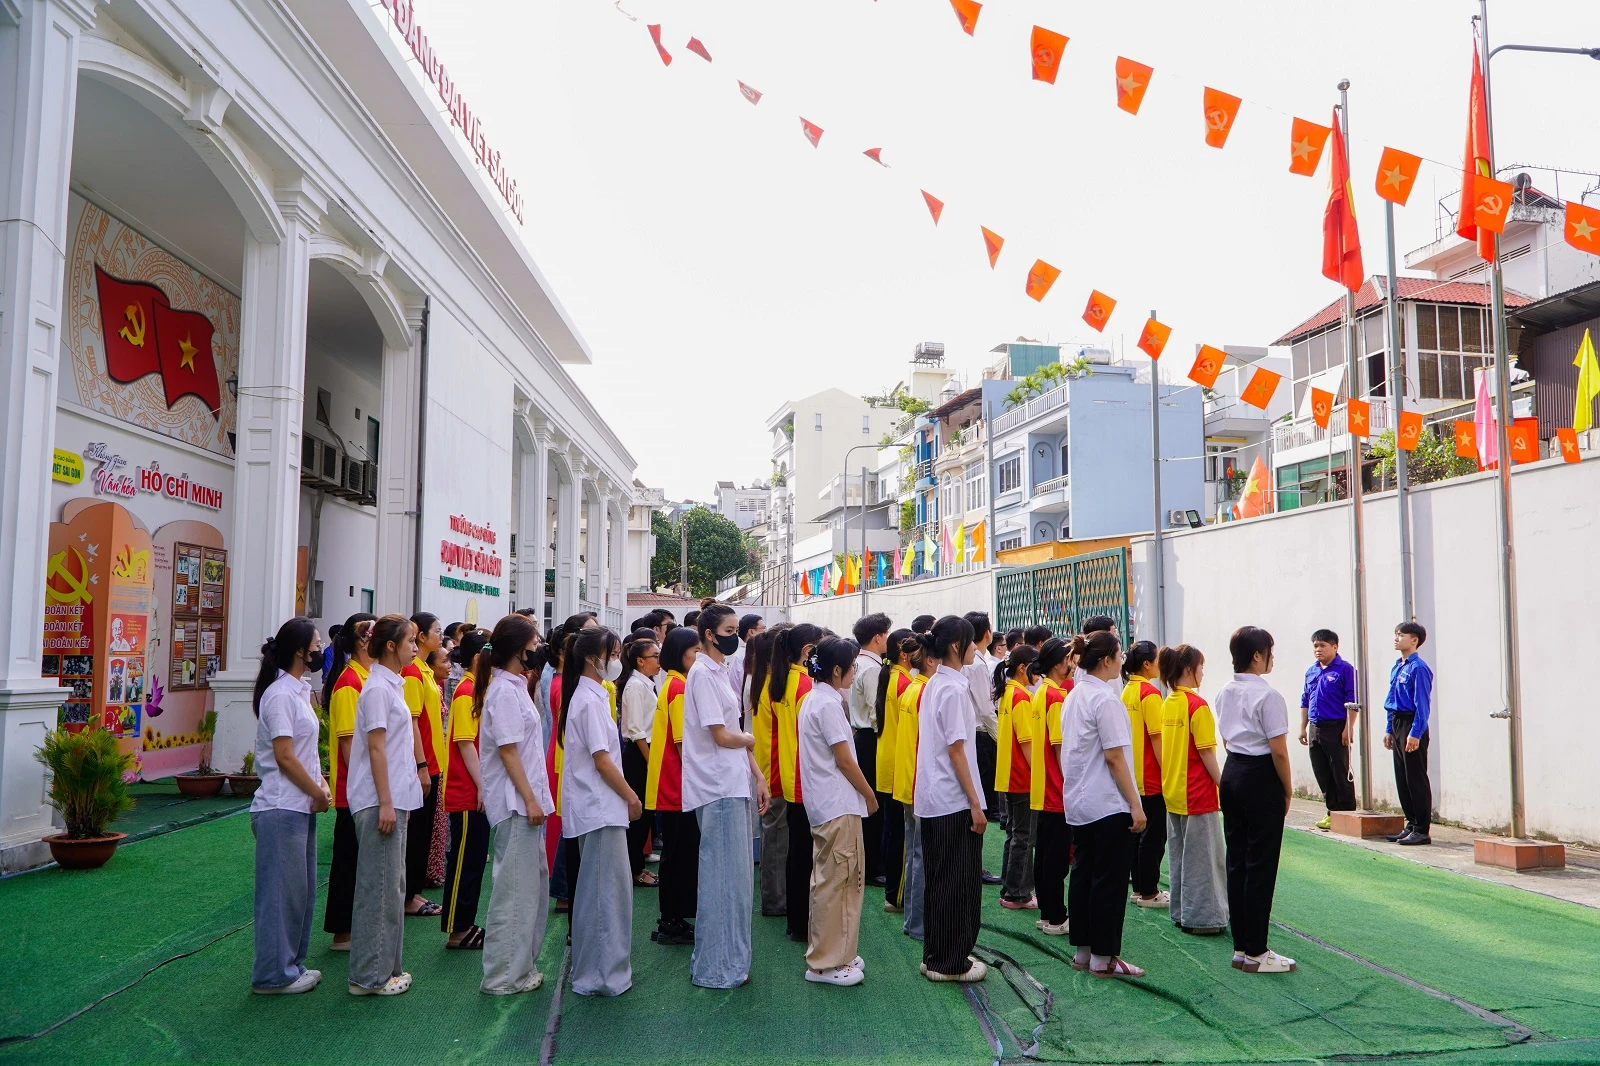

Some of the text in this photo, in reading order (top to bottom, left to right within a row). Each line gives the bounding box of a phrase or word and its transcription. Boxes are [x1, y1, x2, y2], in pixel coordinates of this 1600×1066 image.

[97, 469, 138, 497] Văn hóa
[166, 475, 189, 499] CHÍ
[191, 483, 223, 509] MINH
[44, 602, 85, 615] ĐOÀN KẾT
[68, 619, 84, 632] KẾT
[50, 636, 73, 648] ĐOÀN
[75, 635, 90, 648] KẾT
